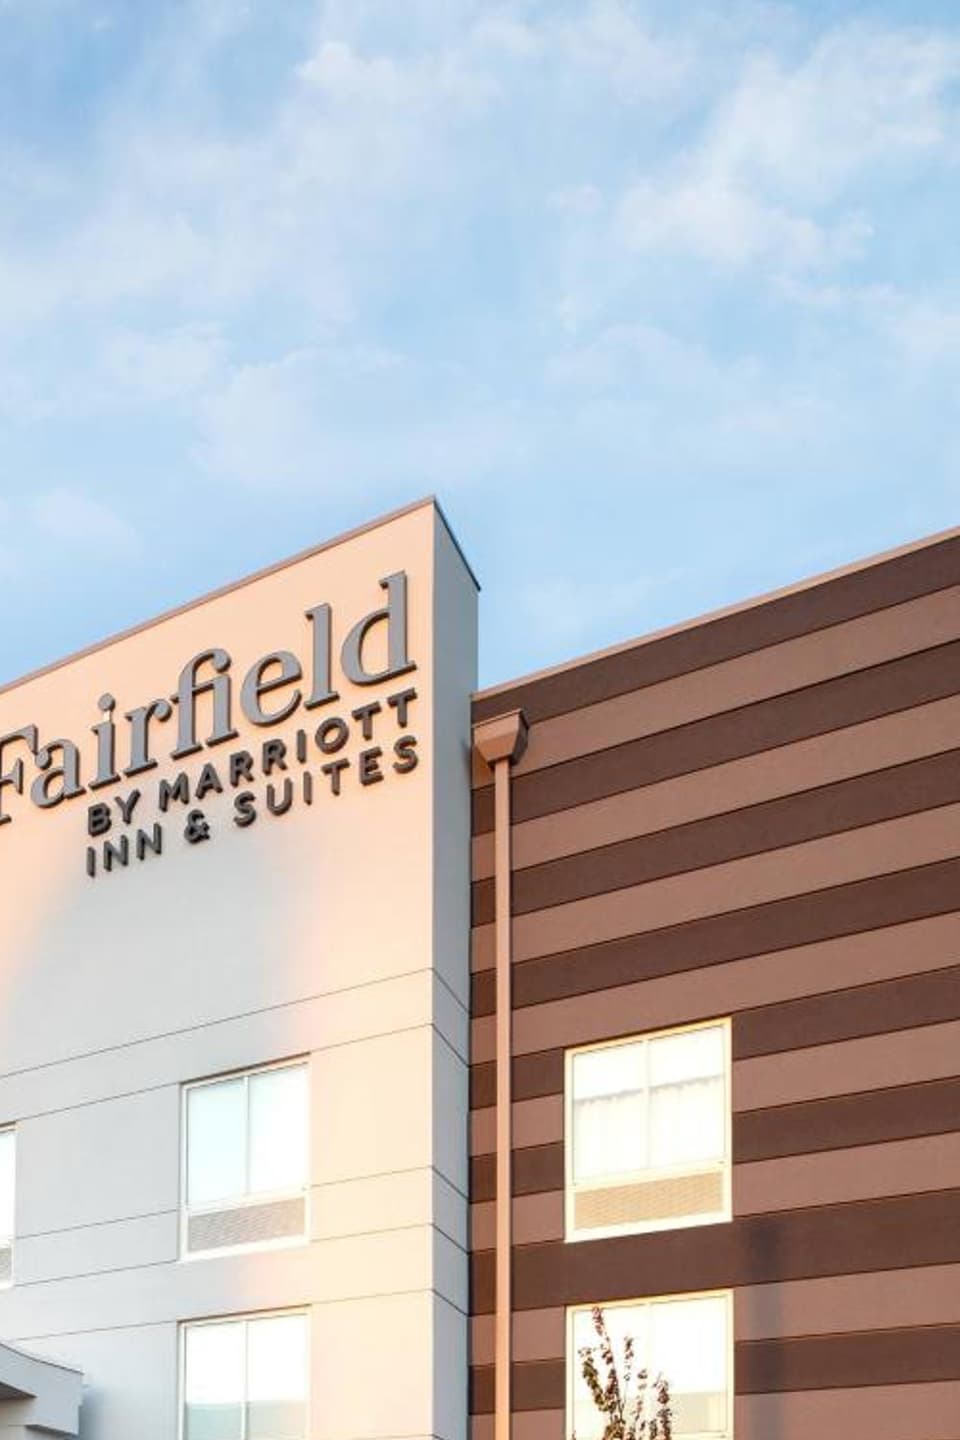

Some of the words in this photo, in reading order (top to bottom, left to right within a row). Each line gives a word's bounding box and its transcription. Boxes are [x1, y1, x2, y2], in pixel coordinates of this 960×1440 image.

[86, 822, 162, 877] INN
[183, 809, 210, 844] &
[234, 734, 419, 828] SUITES
[87, 789, 141, 837] BY
[159, 687, 417, 812] MARRIOTT
